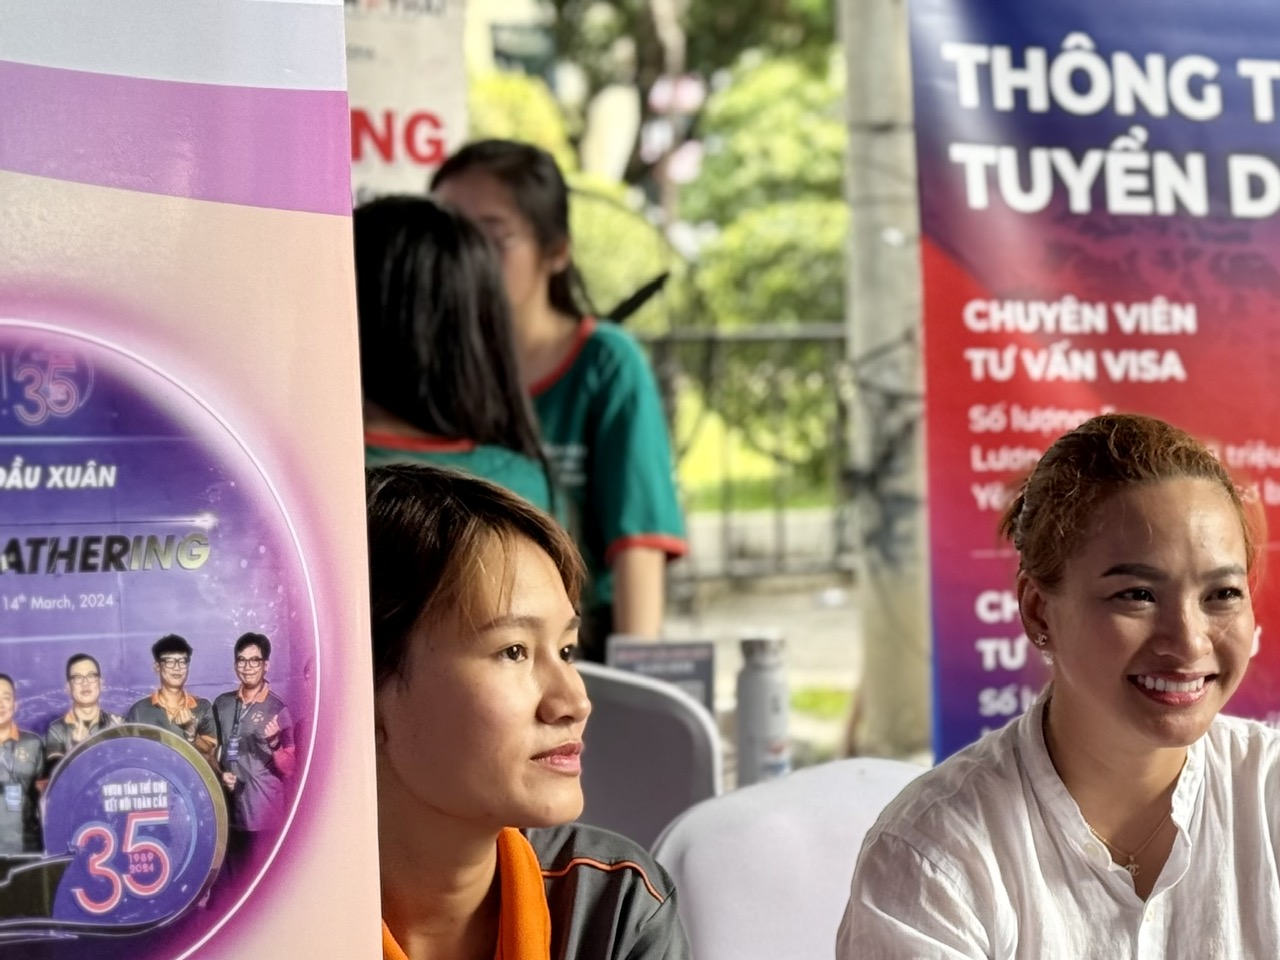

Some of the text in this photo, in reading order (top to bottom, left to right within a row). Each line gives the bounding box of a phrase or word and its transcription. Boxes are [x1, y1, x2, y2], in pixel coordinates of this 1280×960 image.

[941, 32, 1223, 121] THÔNG
[949, 125, 1209, 217] TUYỂN
[962, 294, 1198, 336] CHUYÊN VIÊN
[963, 338, 1188, 383] TƯ VẤN VISA
[46, 460, 117, 488] XUÂN
[31, 595, 76, 611] March,
[79, 594, 114, 608] 2024
[72, 810, 169, 914] 35
